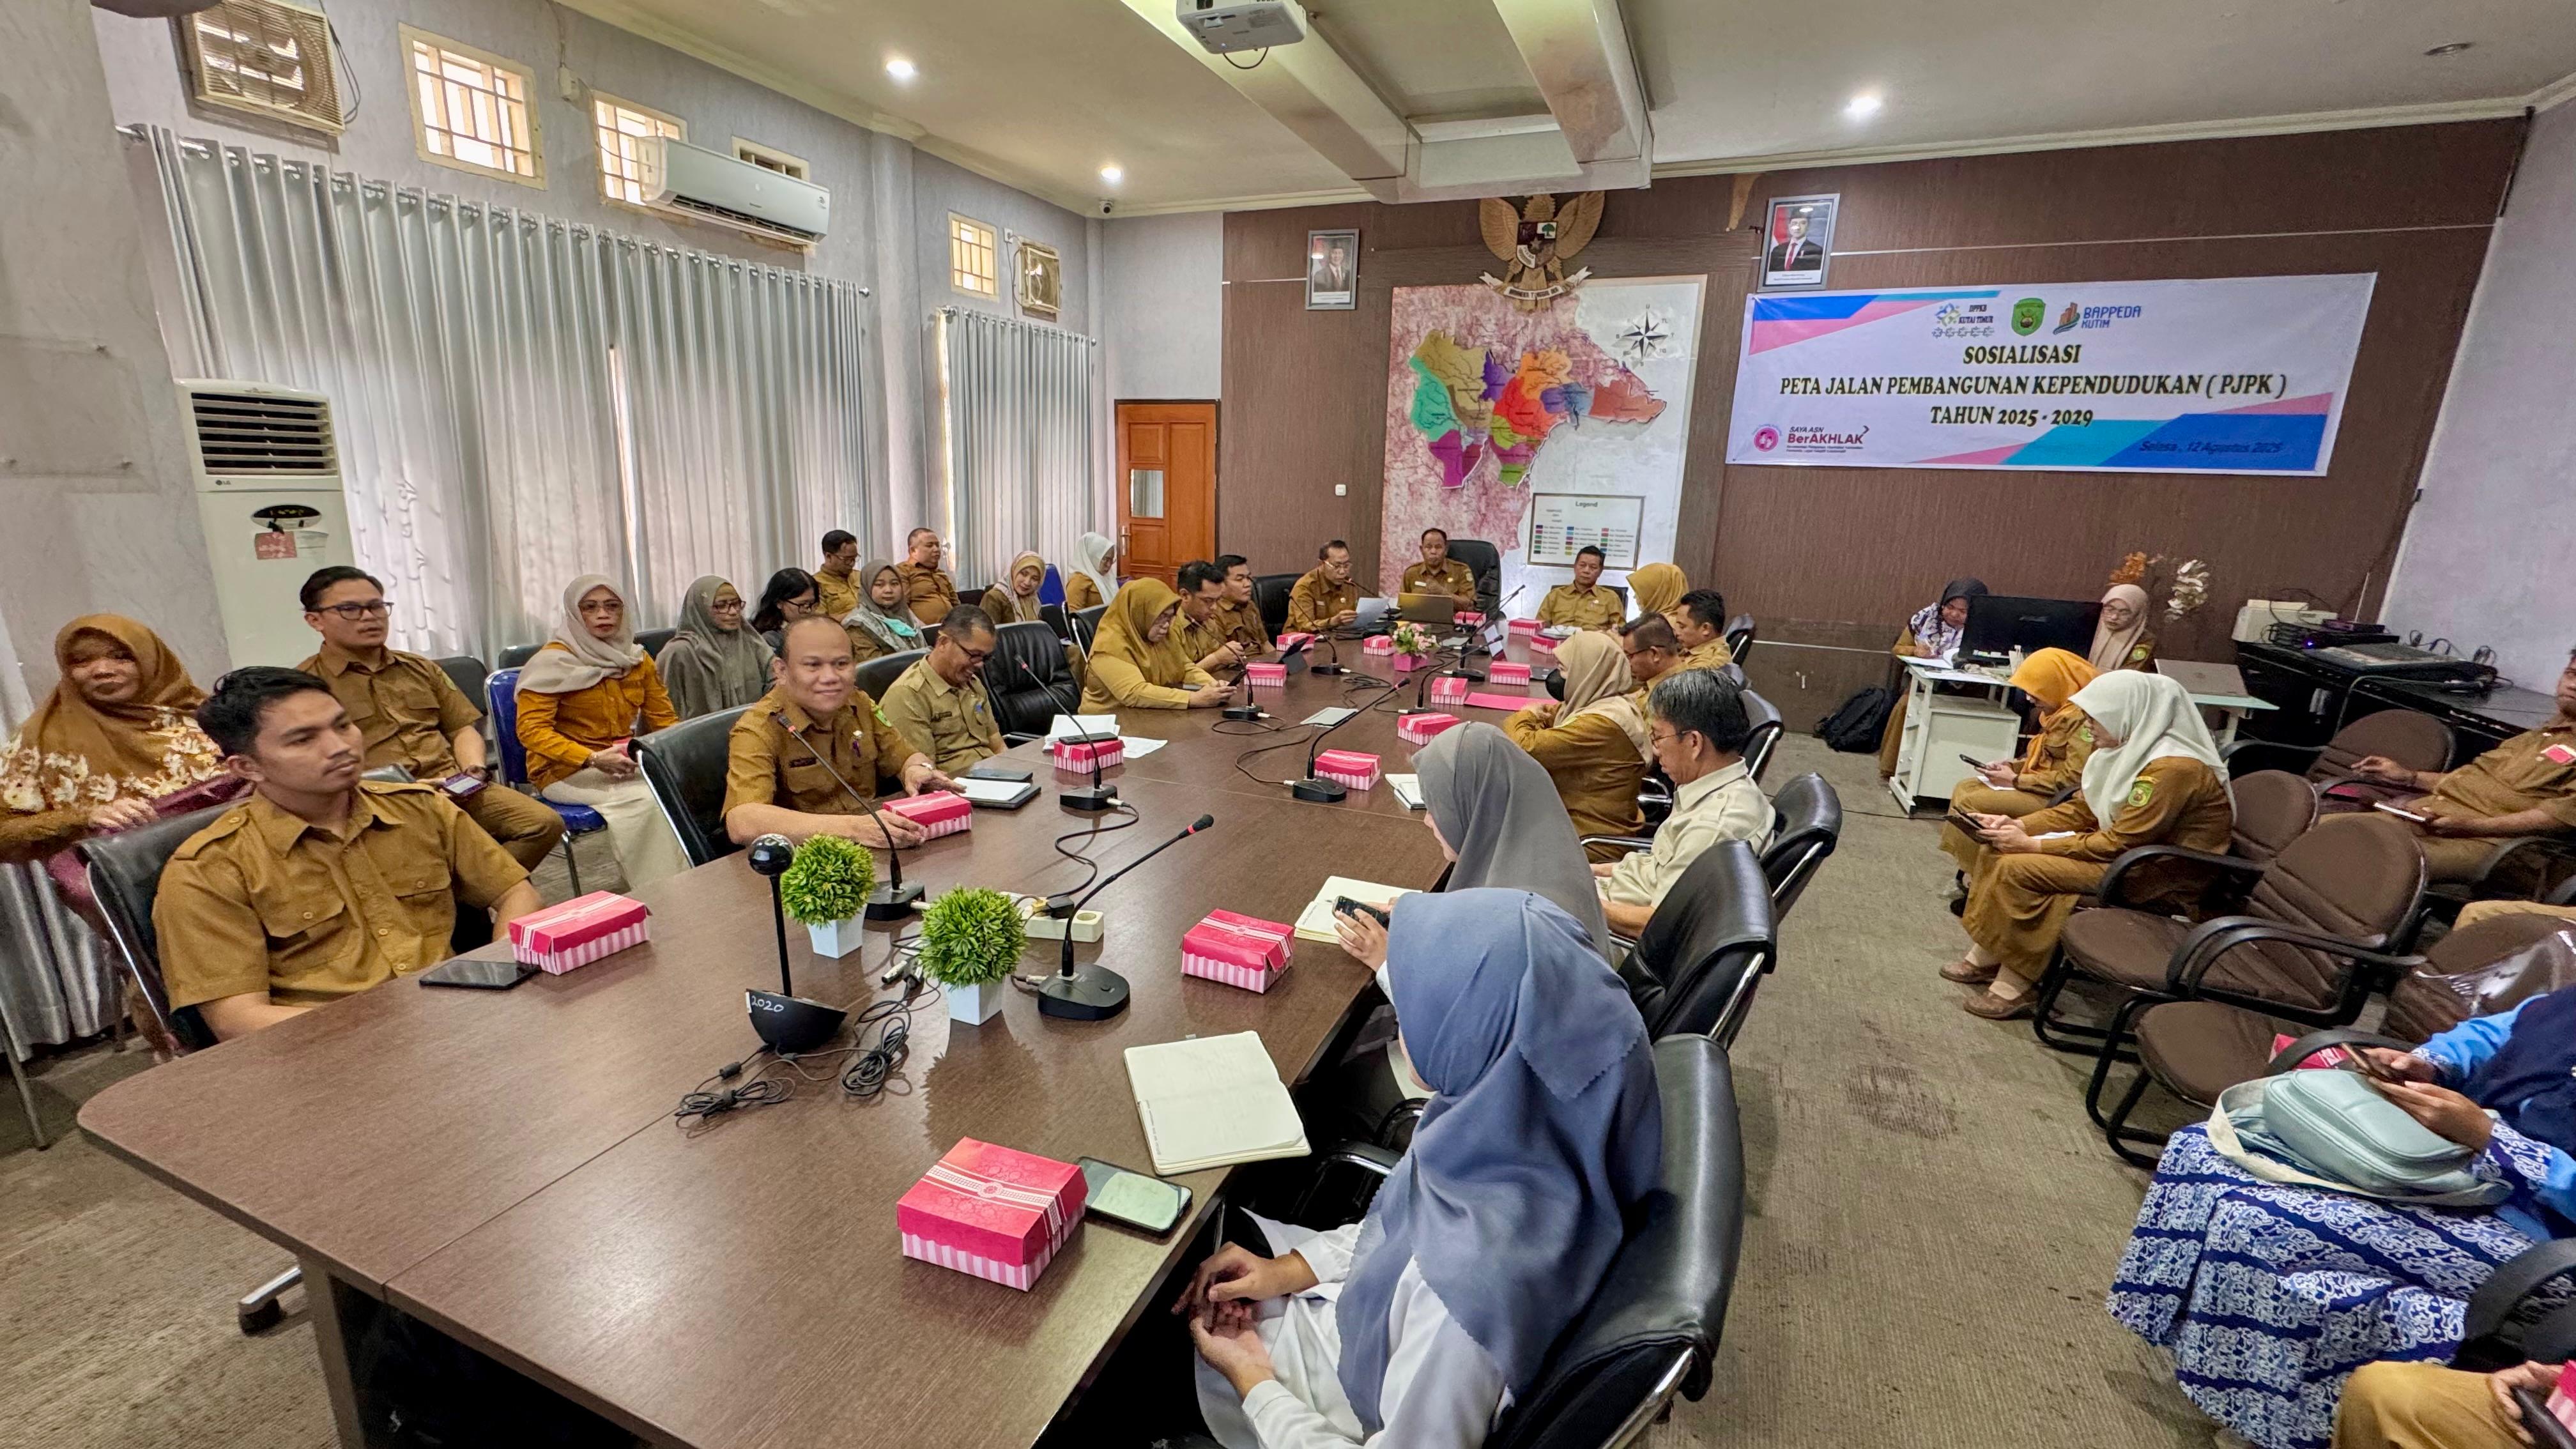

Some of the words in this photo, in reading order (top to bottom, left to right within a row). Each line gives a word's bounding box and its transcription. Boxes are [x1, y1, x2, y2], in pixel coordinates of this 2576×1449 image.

[1976, 316, 1994, 324] TIMUR
[2083, 305, 2142, 319] BAPPEDA
[2082, 319, 2110, 329] KUTIM
[1963, 344, 2082, 364] SOSIALISASI
[1779, 377, 1821, 395] PETA
[1825, 376, 1883, 395] JALAN
[1886, 376, 2029, 395] PEMBANGUNAN
[2032, 374, 2203, 395] KEPENDUDUKAN
[2219, 374, 2274, 394] PJPK
[1931, 406, 1995, 424] TAHUN
[1997, 409, 2039, 427] 2025
[2050, 410, 2094, 427] 2029
[1788, 433, 1864, 444] BerAKHLAK
[751, 995, 785, 1013] 2020
